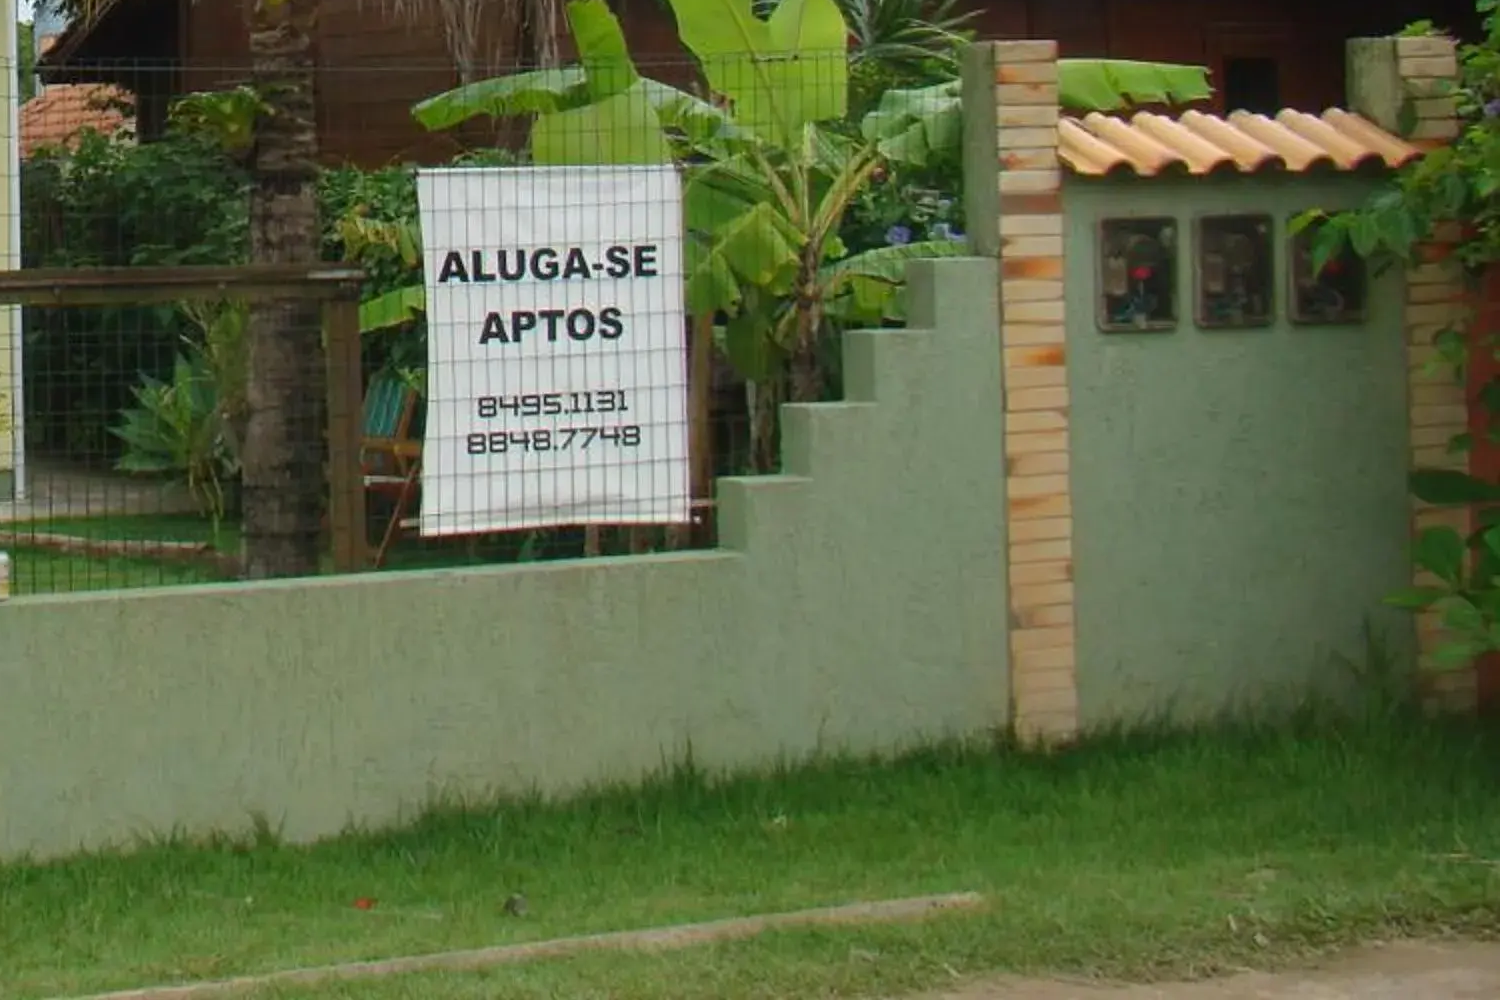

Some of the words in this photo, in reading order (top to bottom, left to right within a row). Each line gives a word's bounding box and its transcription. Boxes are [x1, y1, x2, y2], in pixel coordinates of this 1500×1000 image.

[438, 245, 657, 282] ALUGA-SE
[479, 307, 624, 344] APTOS
[477, 390, 629, 418] 8495.1131
[467, 425, 641, 455] 8848.7748
